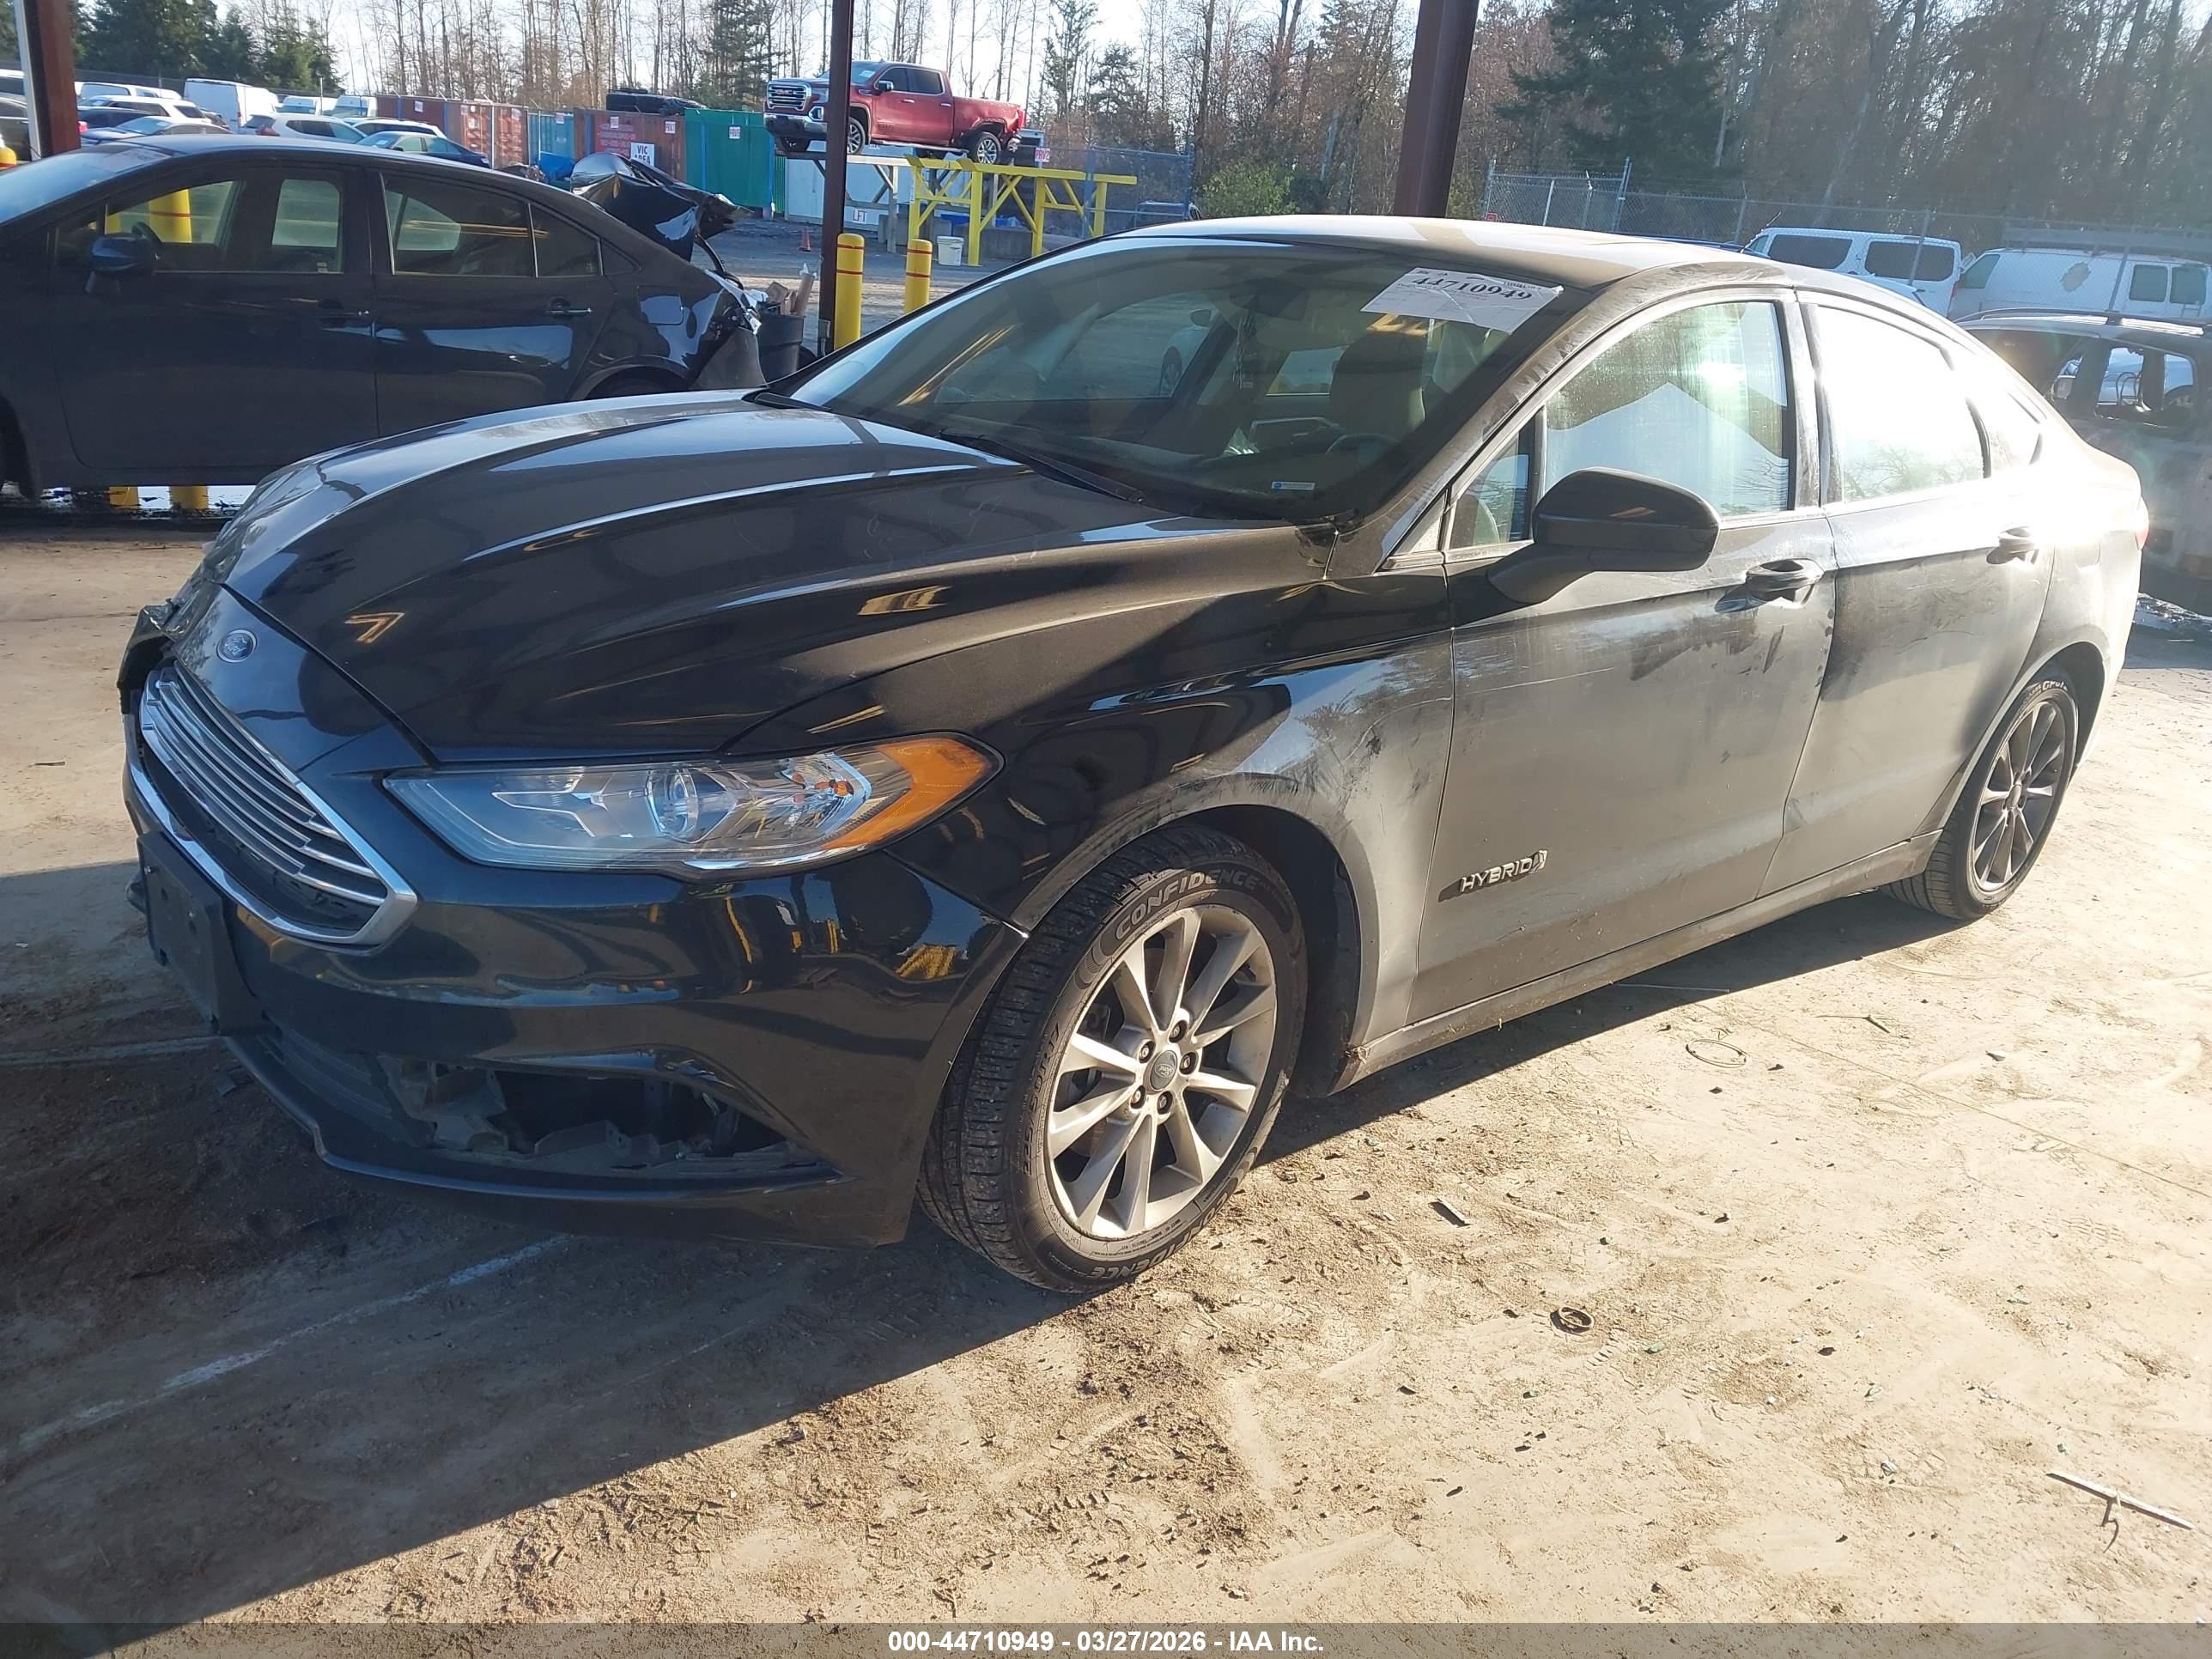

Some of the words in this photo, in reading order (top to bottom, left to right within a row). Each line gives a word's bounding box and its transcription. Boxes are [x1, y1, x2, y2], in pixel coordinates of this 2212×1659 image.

[637, 145, 647, 155] VIC
[1412, 276, 1533, 300] 44710949
[224, 635, 247, 657] Ford
[1462, 858, 1533, 893] HYBRID
[1116, 868, 1256, 940] CONFIDENCE
